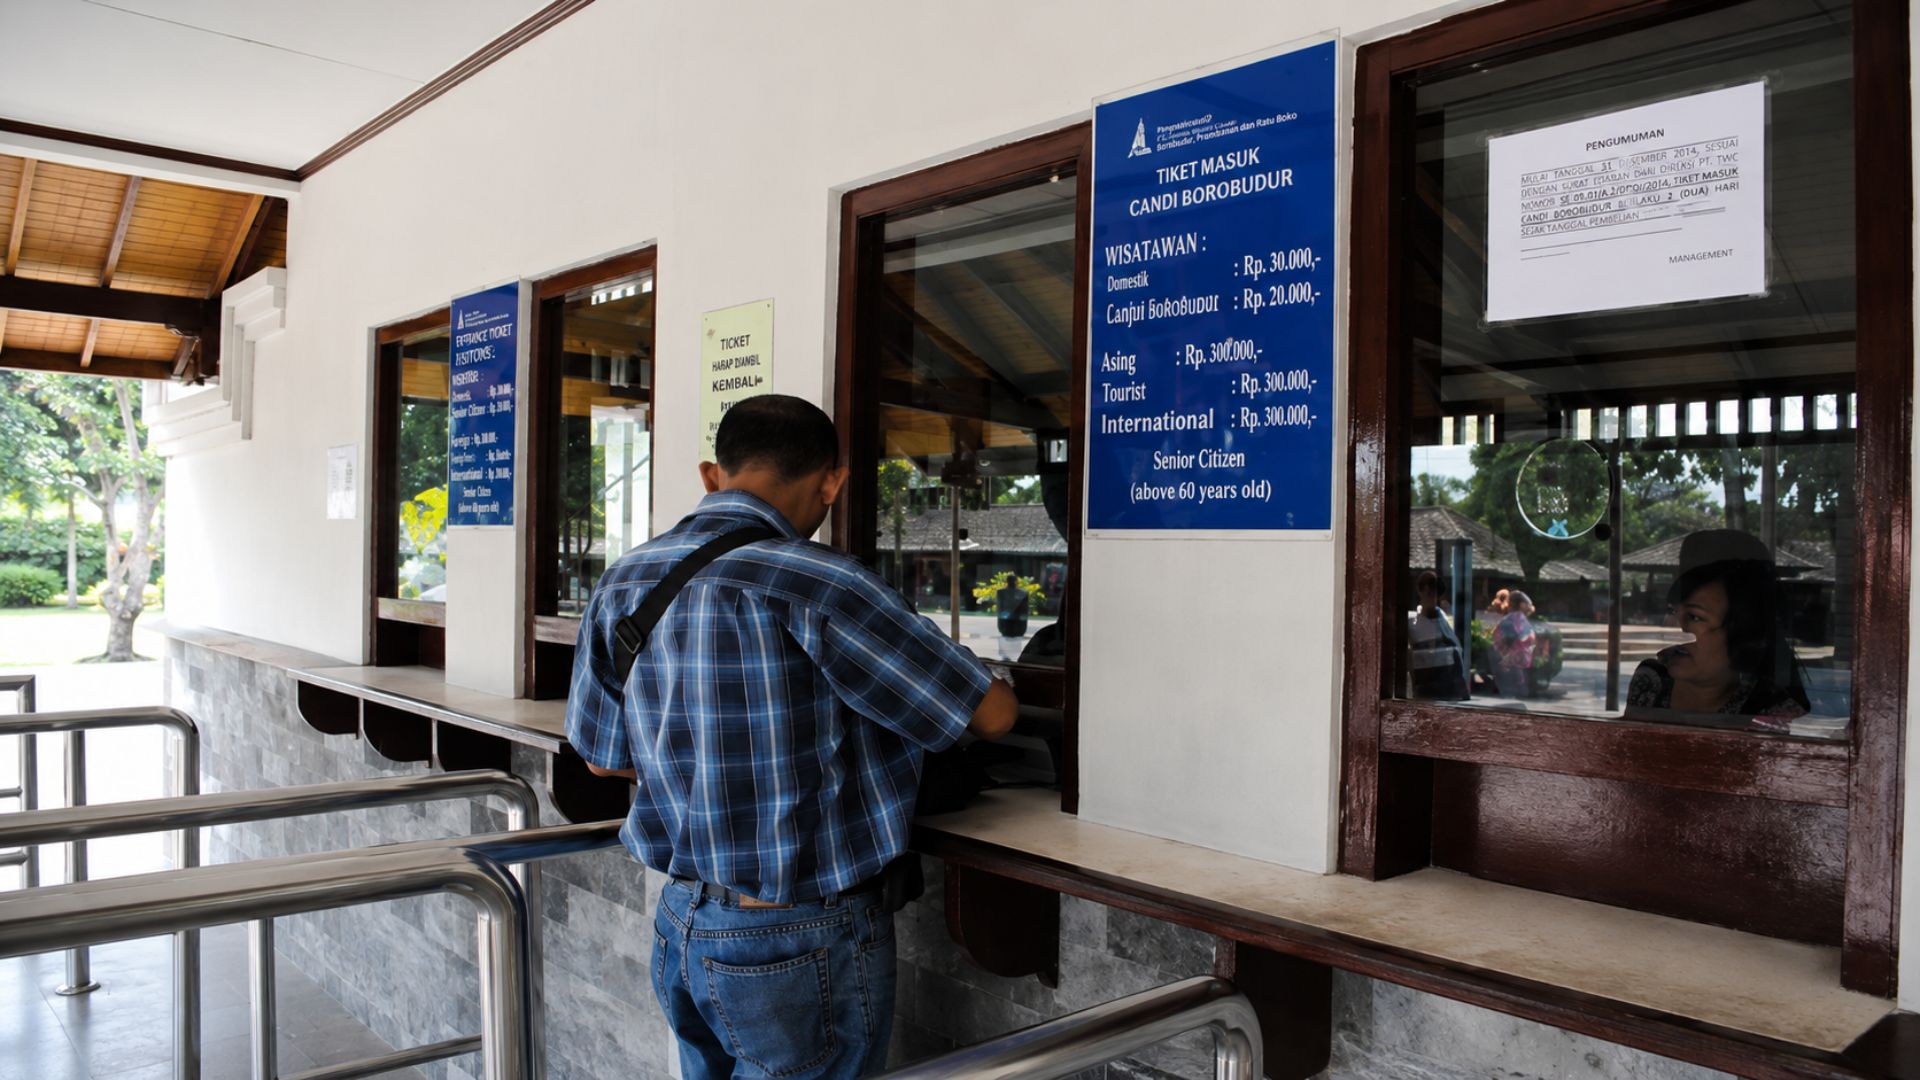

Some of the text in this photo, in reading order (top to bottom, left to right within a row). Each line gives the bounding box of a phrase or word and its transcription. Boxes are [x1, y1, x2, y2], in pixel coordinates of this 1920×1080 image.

[1240, 121, 1255, 132] dan
[1256, 117, 1275, 127] Ratu
[1276, 112, 1298, 124] Boko
[1586, 129, 1664, 151] PENGUMUMAN
[1706, 139, 1738, 152] SESUAI
[1156, 146, 1260, 185] TIKET MASUK
[1717, 153, 1739, 163] TWC
[1702, 167, 1738, 181] MASUK
[1129, 168, 1294, 217] CANDI BOROBUDUR
[1521, 212, 1548, 224] CANDI
[1680, 186, 1709, 200] (DUA)
[1714, 181, 1739, 192] HARI
[1547, 220, 1586, 232] TANGGAL
[1105, 232, 1198, 266] WISATAWAN
[1669, 248, 1734, 264] MANAGEMENT
[1107, 270, 1149, 292] Domestik
[1244, 255, 1266, 281] Rp.
[1269, 247, 1321, 272] 30.000,-
[1243, 288, 1266, 314] Rp.
[1269, 282, 1321, 307] 20.000,-
[720, 334, 751, 351] TICKET
[1101, 351, 1136, 376] Asing
[1185, 344, 1207, 370] Rp.
[1102, 381, 1146, 402] Tourist
[1241, 373, 1261, 400] Rp.
[1264, 369, 1317, 394] 300.000,-
[1102, 408, 1214, 434] International
[1240, 406, 1261, 433] Rp.
[1264, 404, 1317, 429] 300.000,-
[1153, 448, 1245, 471] Senior Citizen
[1130, 480, 1271, 504] (above 60 years old)
